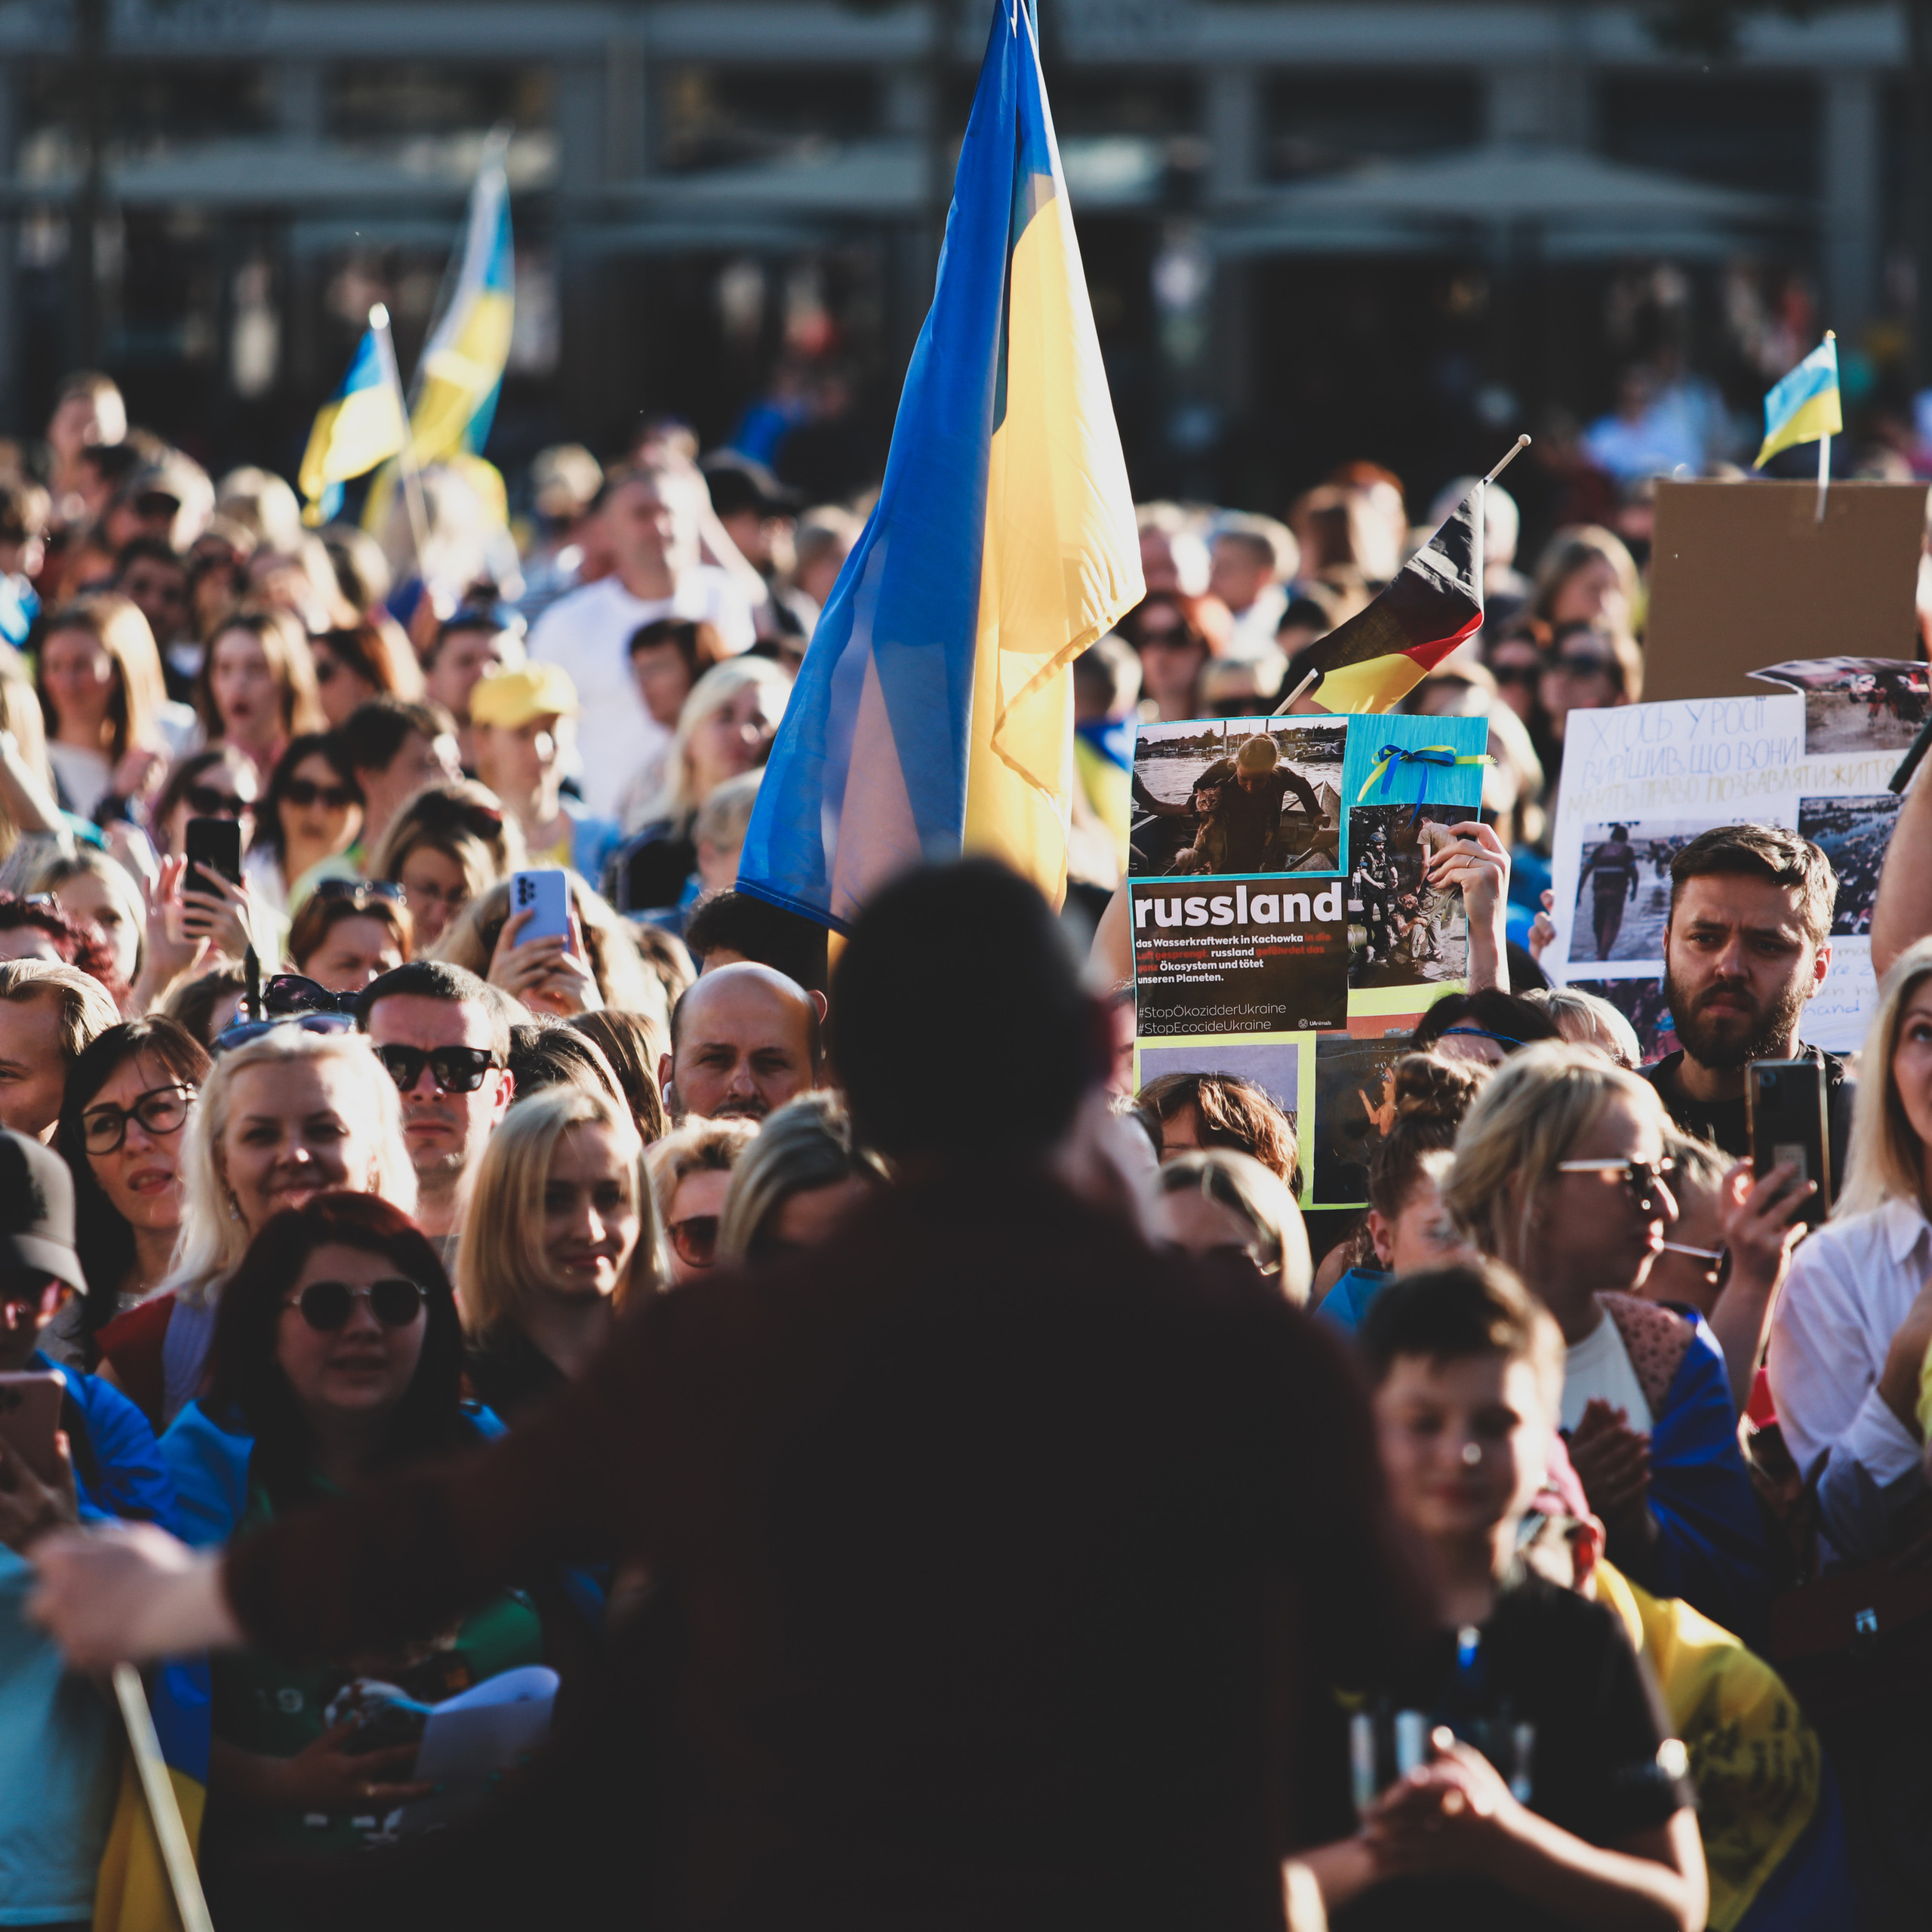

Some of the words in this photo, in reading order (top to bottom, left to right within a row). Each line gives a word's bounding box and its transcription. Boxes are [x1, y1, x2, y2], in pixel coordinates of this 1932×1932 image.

[1737, 737, 1798, 771] ВОНИ
[1135, 882, 1342, 928] russland
[1136, 939, 1152, 949] das
[1153, 936, 1239, 947] Wasserkraftwerk
[1241, 935, 1251, 944] in
[1251, 933, 1303, 944] Kachowka
[1137, 950, 1154, 960] Luft
[1211, 946, 1254, 957] russland
[1256, 946, 1305, 958] gefährdet
[1307, 945, 1324, 954] das
[1159, 961, 1217, 972] Ökosystem
[1219, 960, 1238, 969] und
[1239, 958, 1264, 968] tötet
[1137, 975, 1175, 984] unseren
[1176, 973, 1224, 983] Planeten.
[1138, 1003, 1287, 1019] #StopÖkozidderUkraine
[1138, 1020, 1272, 1035] #StopEcocideUkraine
